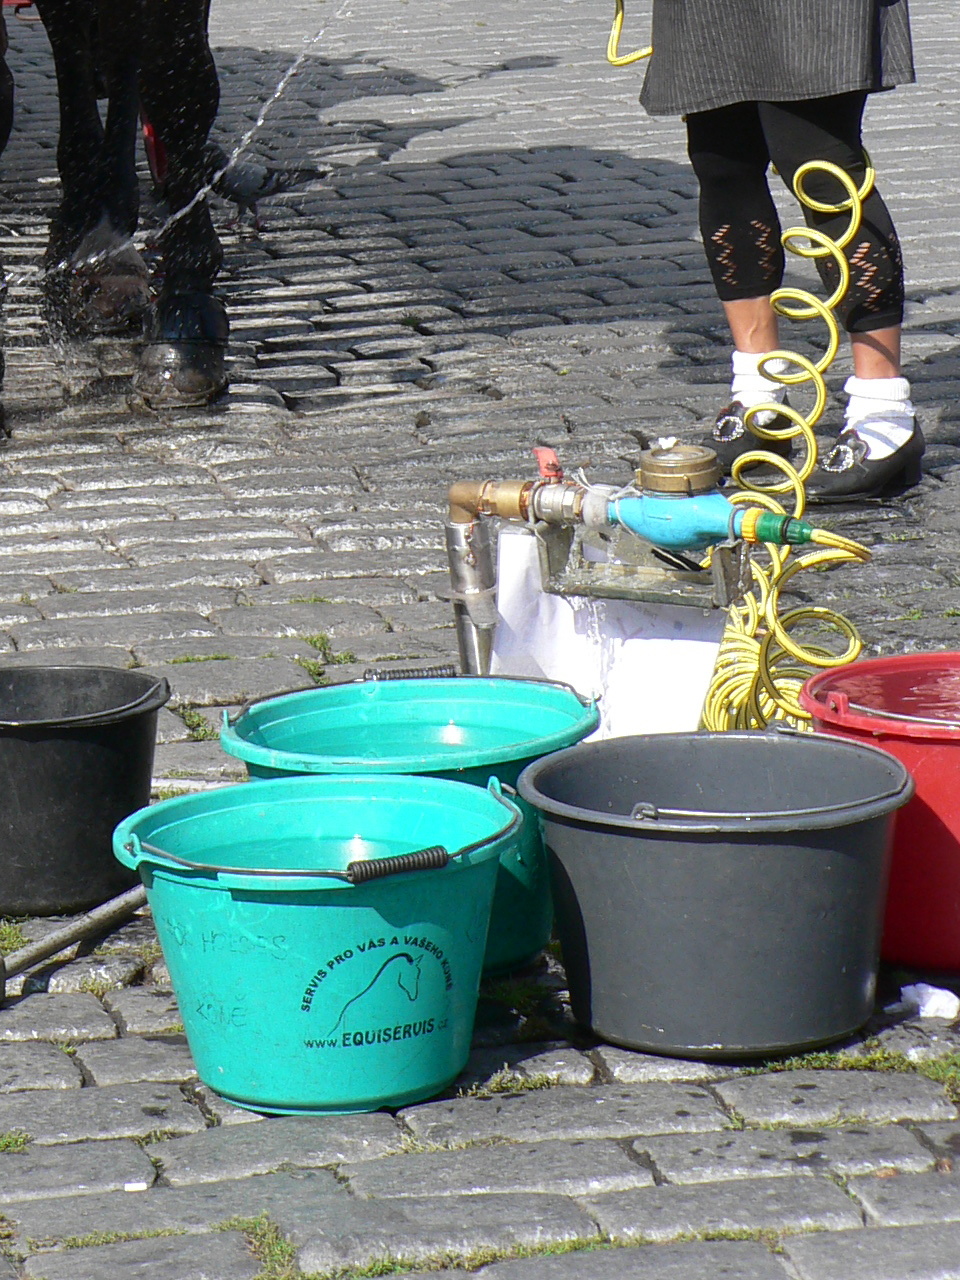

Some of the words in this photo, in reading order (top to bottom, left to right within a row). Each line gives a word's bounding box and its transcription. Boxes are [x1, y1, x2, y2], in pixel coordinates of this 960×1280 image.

[301, 969, 328, 1013] SERVIS
[326, 949, 354, 971] PRO
[390, 936, 400, 946] A
[403, 935, 444, 960] VAŠEHO
